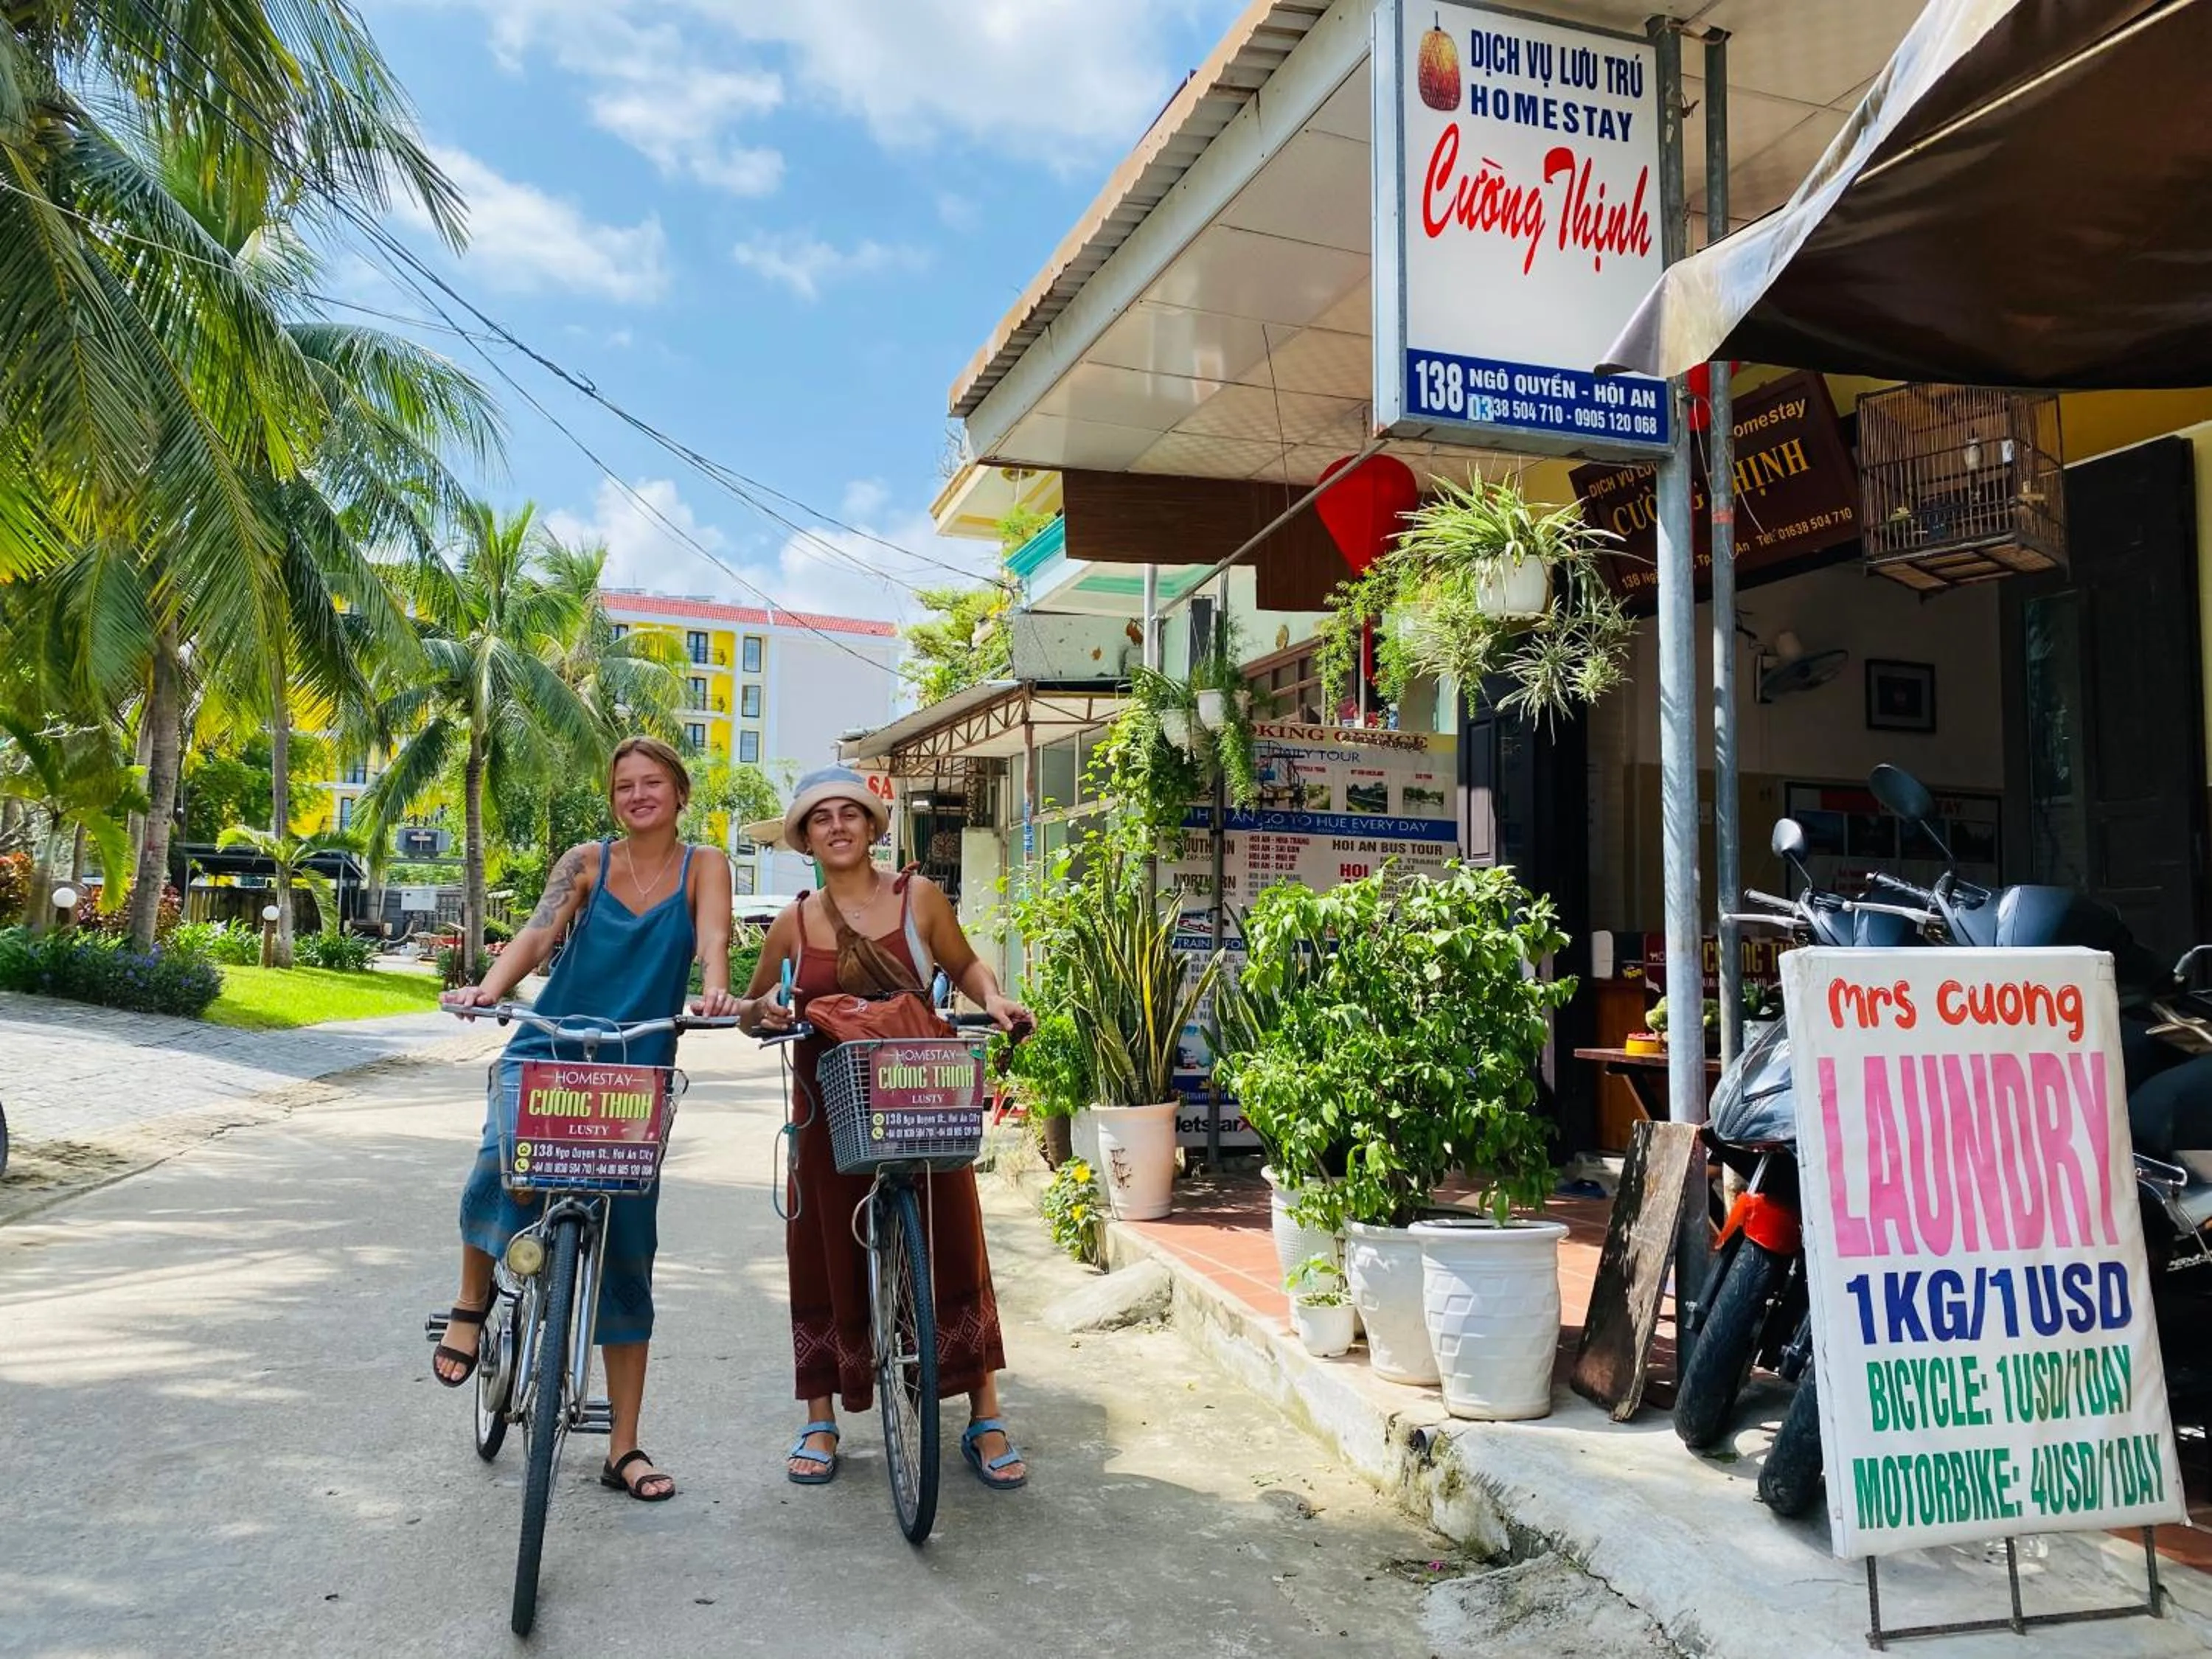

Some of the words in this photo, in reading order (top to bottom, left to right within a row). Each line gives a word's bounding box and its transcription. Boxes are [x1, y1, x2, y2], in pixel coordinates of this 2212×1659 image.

[1472, 29, 1519, 77] DỊCH
[1526, 40, 1552, 88] VỤ
[1560, 47, 1598, 90] LƯU
[1604, 54, 1643, 98] TRÚ
[1472, 84, 1632, 142] HOMESTAY
[1423, 122, 1546, 275] Cường
[1544, 147, 1652, 272] Thịnh
[1416, 360, 1464, 412] 138
[1470, 368, 1509, 391] NGÔ
[1594, 382, 1624, 408] HỘI
[1630, 389, 1656, 408] AN
[1513, 401, 1536, 421] 504
[1540, 404, 1563, 424] 710
[1575, 408, 1605, 428] 0905
[1609, 413, 1631, 432] 120
[1635, 416, 1657, 434] 068
[1733, 398, 1806, 437] omestay
[1733, 438, 1811, 496] HỊNH
[1588, 476, 1616, 499] DỊCH
[1811, 514, 1832, 530] 504
[1832, 507, 1853, 522] 710
[1642, 569, 1658, 585] Ng
[1319, 751, 1360, 762] TOUR
[1316, 816, 1347, 828] HUE
[1352, 818, 1395, 830] EVERY
[1399, 822, 1428, 832] DAY
[1332, 840, 1354, 851] HOI
[1358, 842, 1377, 852] AN
[1381, 843, 1406, 854] BUS
[1411, 844, 1442, 855] TOUR
[1340, 863, 1369, 877] HOI
[896, 1049, 956, 1061] HOMESTAY
[555, 1071, 633, 1085] HOMESTAY
[912, 1094, 944, 1104] LUSTY
[568, 1124, 610, 1135] LUSTY
[886, 1112, 902, 1124] 138
[532, 1144, 553, 1157] 138
[1818, 1051, 2119, 1258] LAUNDRY
[1846, 1261, 2132, 1345] 1KG/1USD
[1866, 1356, 1993, 1432] BICYCLE:
[1996, 1345, 2132, 1424] 1USD/1DAY
[1853, 1447, 2023, 1529] MOTORBIKE:
[2031, 1433, 2165, 1516] 4USD/1DAY
